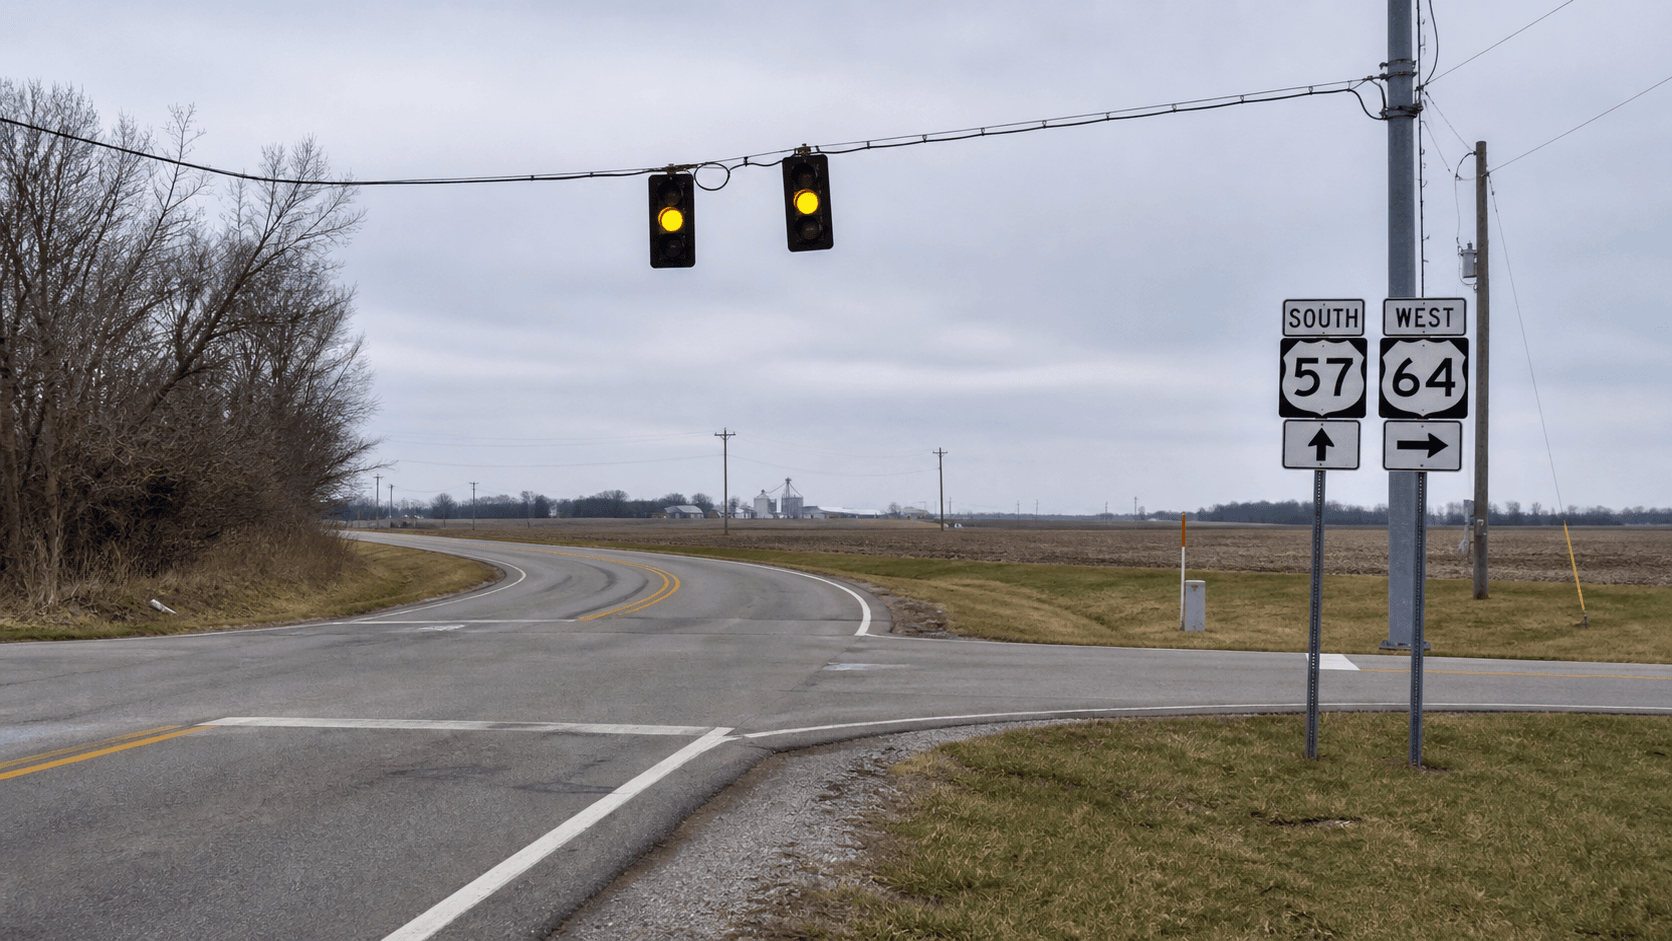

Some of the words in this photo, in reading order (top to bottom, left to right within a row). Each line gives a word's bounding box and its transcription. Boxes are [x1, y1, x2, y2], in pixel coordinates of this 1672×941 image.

[1288, 308, 1359, 329] SOUTH
[1395, 307, 1454, 328] WEST
[1293, 357, 1354, 397] 57
[1392, 357, 1456, 397] 64
